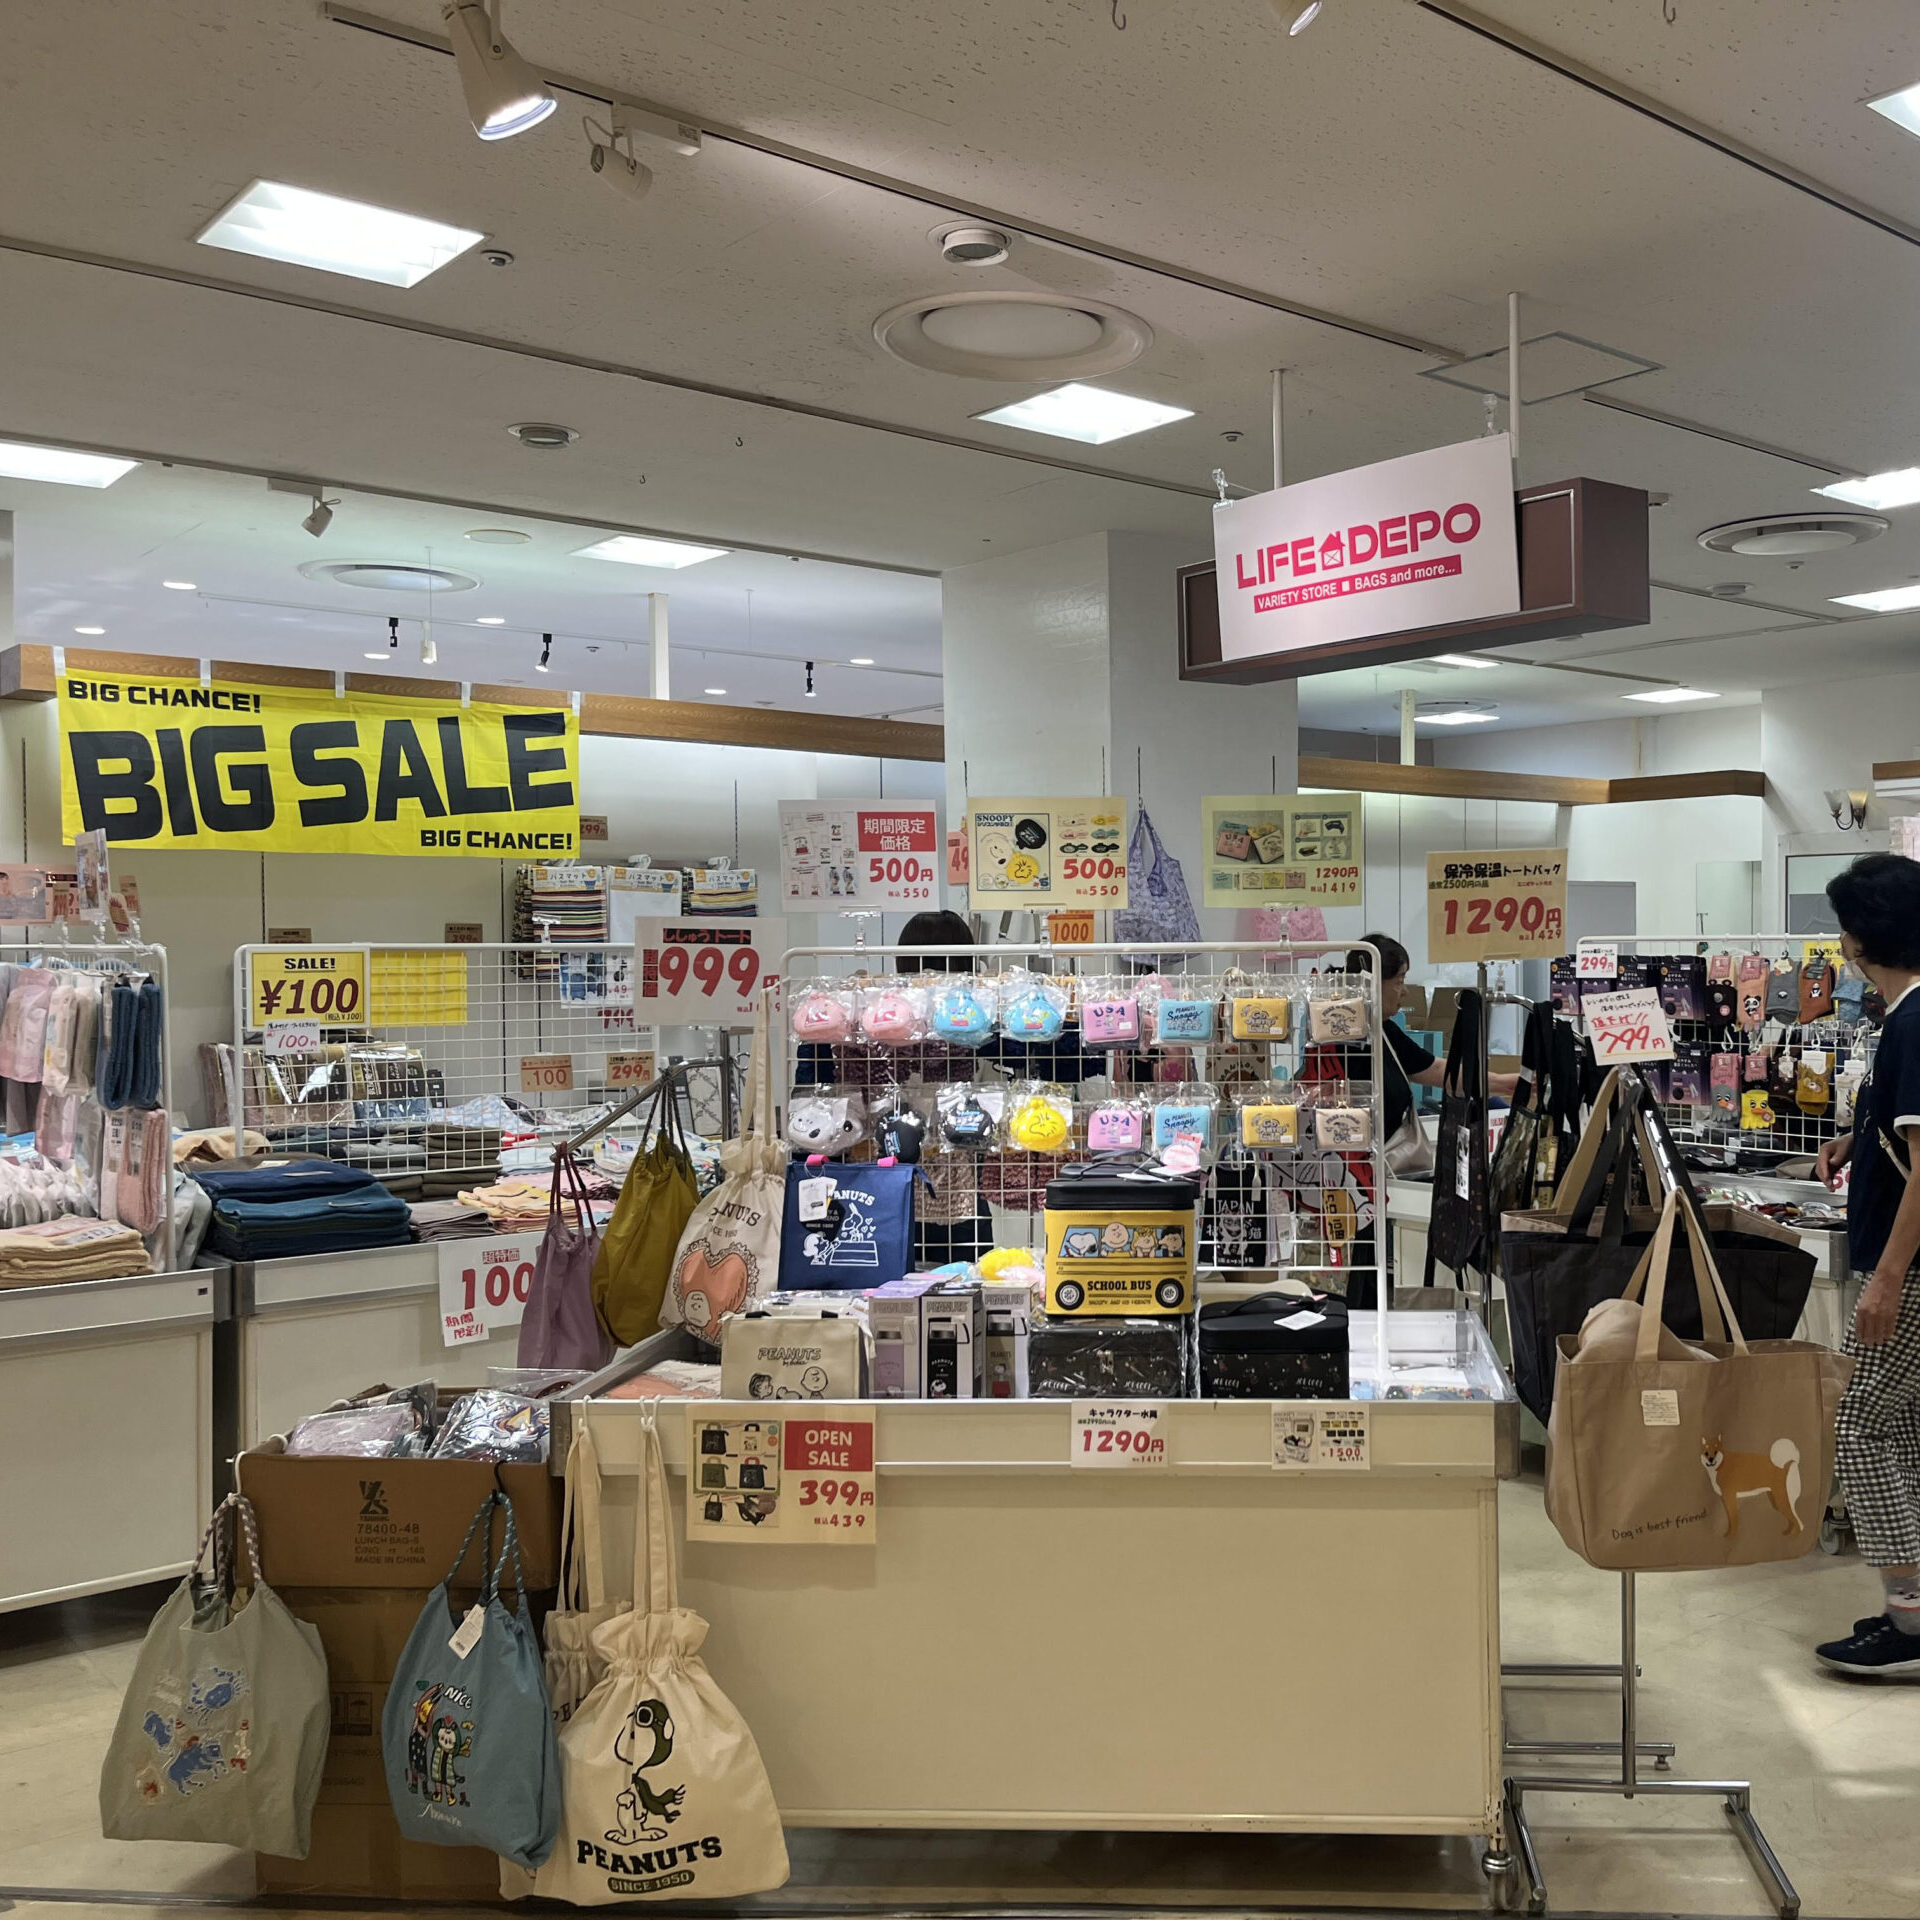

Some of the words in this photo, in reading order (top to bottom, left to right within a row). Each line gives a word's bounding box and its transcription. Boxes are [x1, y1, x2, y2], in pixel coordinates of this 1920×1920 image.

[1236, 536, 1316, 589] LIFE
[1347, 502, 1481, 565] DEPO
[1257, 590, 1300, 610] VARIETY
[1302, 582, 1337, 601] STORE
[1354, 572, 1387, 590] BAGS
[1390, 567, 1412, 584] and
[1414, 563, 1456, 580] more...
[68, 680, 120, 703] BIG
[127, 686, 262, 714] CHANCE!
[68, 724, 276, 842] BIG
[290, 712, 574, 827] SALE
[863, 818, 926, 834] 期間限定
[976, 814, 1014, 822] SNOOPY
[420, 830, 461, 848] BIG
[466, 830, 573, 850] CHANCE!
[880, 835, 911, 851] 価格
[869, 857, 933, 883] 500円
[1063, 858, 1126, 879] 500円
[1316, 866, 1359, 879] 1290円
[1444, 862, 1561, 879] 保冷保温トートバッグ
[1444, 896, 1562, 935] 1290円
[284, 957, 336, 970] SALE!
[1581, 956, 1614, 971] 299円
[260, 978, 359, 1015] ¥100
[1093, 1004, 1125, 1018] USA
[1099, 1114, 1130, 1127] USA
[1087, 1280, 1128, 1291] SCHOOL
[1130, 1280, 1152, 1290] BUS
[757, 1347, 822, 1360] PEANUTS
[805, 1429, 852, 1446] OPEN
[1083, 1429, 1164, 1453] 1290円
[808, 1450, 849, 1467] SALE
[799, 1479, 874, 1507] 399円
[357, 1523, 420, 1534] 78400-48
[1612, 1528, 1634, 1540] Dog
[1635, 1526, 1643, 1534] is
[1646, 1517, 1672, 1532] best
[1675, 1507, 1707, 1528] friend
[355, 1537, 387, 1545] LUNCH
[355, 1556, 381, 1564] MADE
[384, 1556, 394, 1564] IN
[396, 1555, 426, 1564] CHINA
[443, 1686, 473, 1710] NICE
[577, 1836, 723, 1874] PEANUTS
[610, 1877, 650, 1891] SINCE
[655, 1872, 690, 1889] 1950
